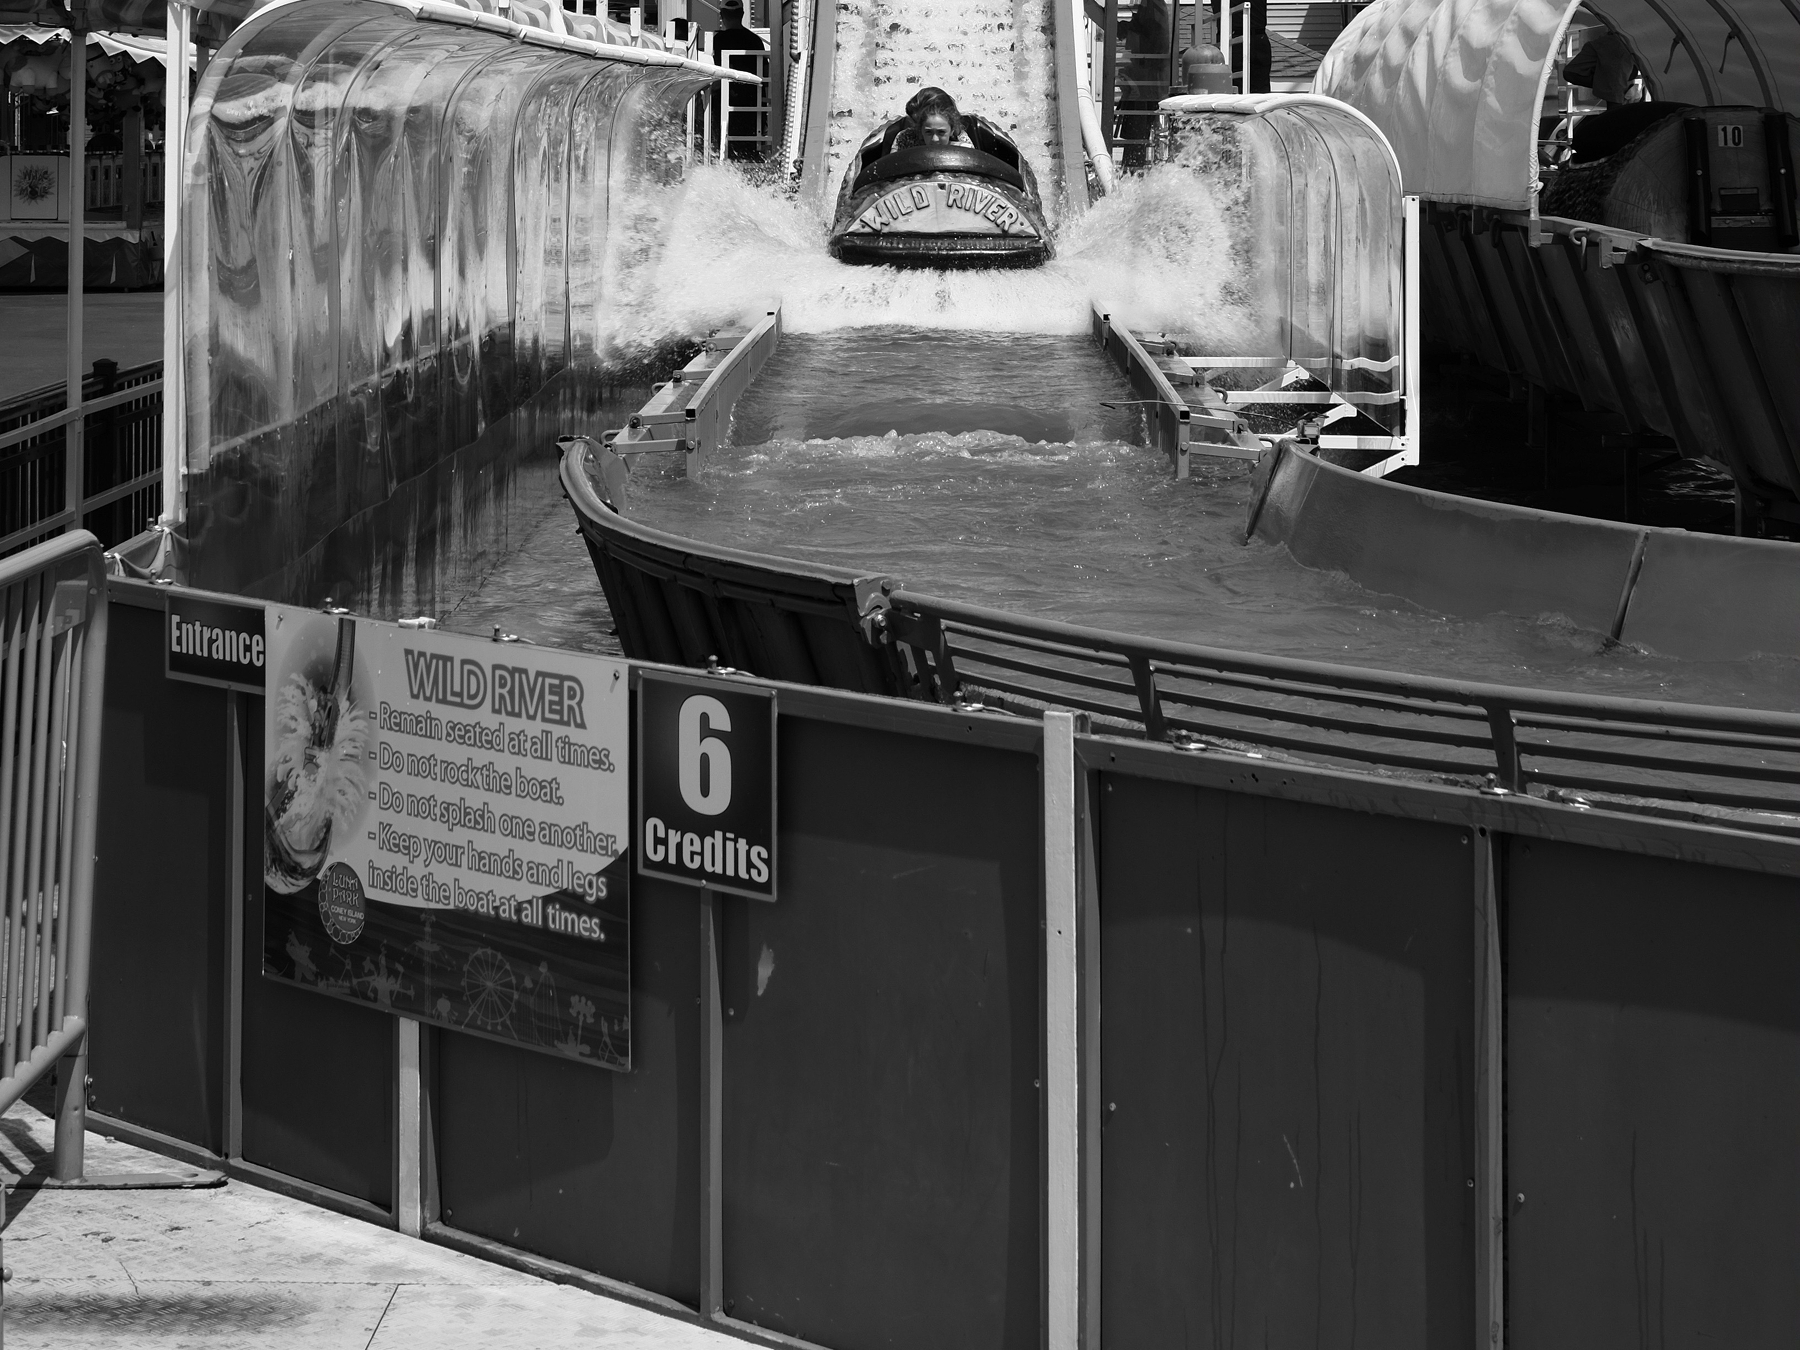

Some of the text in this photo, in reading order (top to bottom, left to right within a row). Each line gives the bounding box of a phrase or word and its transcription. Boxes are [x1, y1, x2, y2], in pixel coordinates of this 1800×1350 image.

[1721, 125, 1742, 146] 10
[861, 183, 1020, 233] WILD RIVER
[171, 614, 265, 667] Entrance
[404, 648, 587, 730] WILD RIVER
[379, 701, 442, 740] Remain
[445, 721, 505, 753] seated
[508, 729, 527, 757] at
[530, 730, 552, 762] all
[555, 735, 615, 773] times.
[679, 694, 732, 816] 6
[379, 742, 404, 773] Do
[407, 753, 437, 781] not
[440, 758, 481, 790] rock
[481, 762, 512, 795] the
[515, 767, 564, 806] boat.
[379, 782, 404, 813] Do
[407, 795, 437, 821] not
[439, 798, 495, 834] splash
[499, 813, 536, 842] one
[538, 821, 620, 860] another.
[645, 816, 769, 884] Credits
[333, 872, 358, 891] LUNA
[379, 822, 421, 864] Keep
[423, 838, 465, 867] your
[468, 841, 524, 880] hands
[526, 859, 564, 890] and
[567, 861, 608, 901] legs
[331, 905, 364, 920] CONEY ISLAND
[333, 888, 359, 908] PARK
[368, 860, 606, 942] inside the boat at all times.
